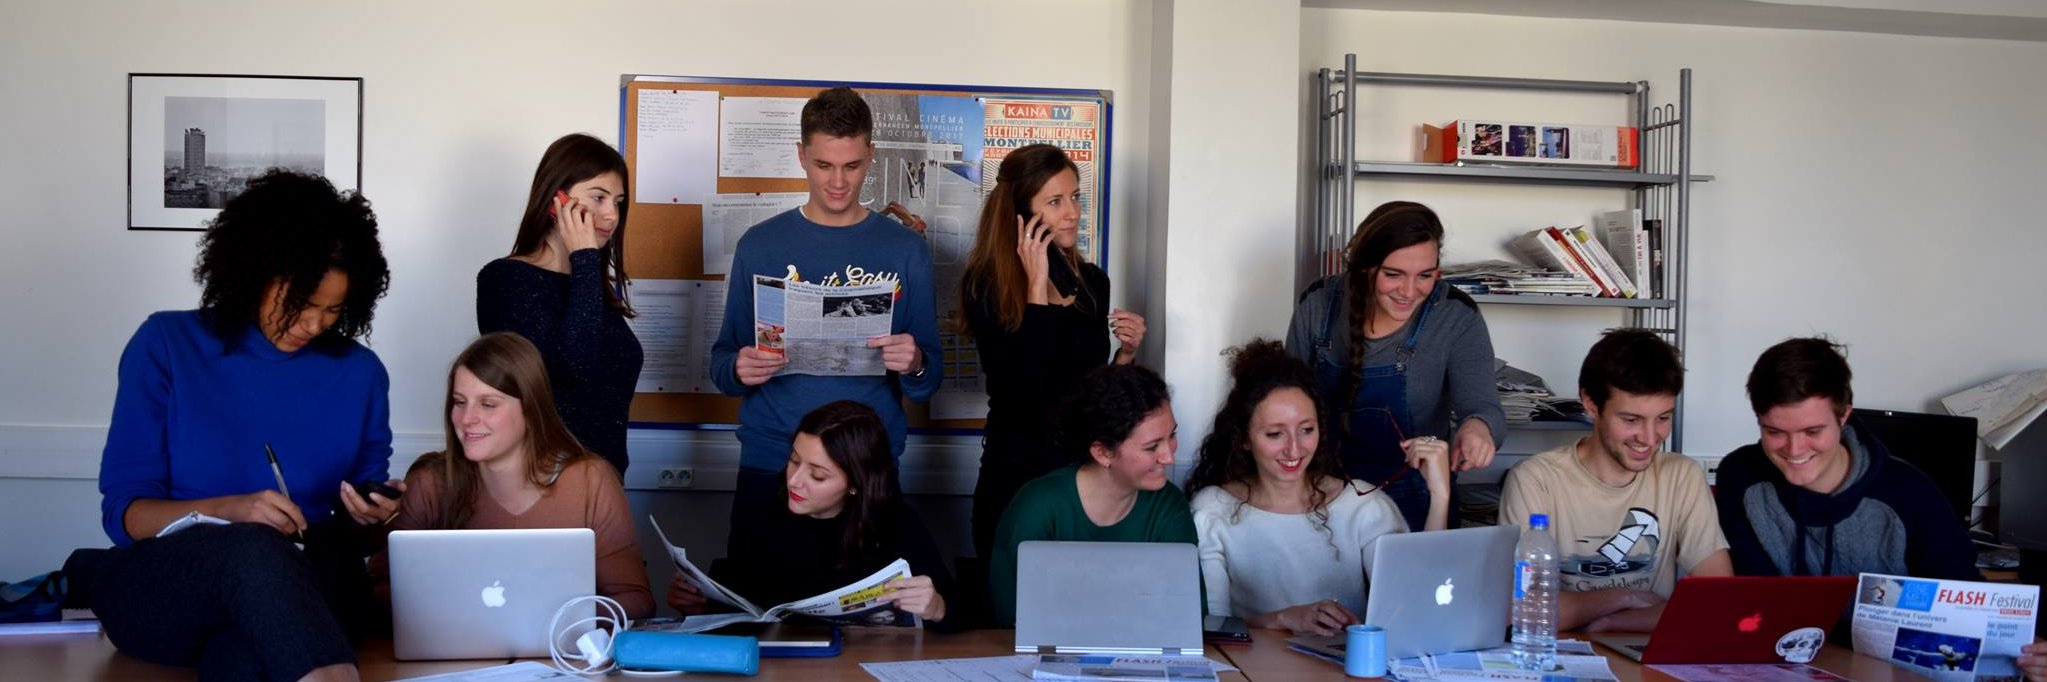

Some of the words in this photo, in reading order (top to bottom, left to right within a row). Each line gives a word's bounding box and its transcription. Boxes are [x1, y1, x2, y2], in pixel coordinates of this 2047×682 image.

[872, 112, 910, 121] TIVAL
[1007, 106, 1049, 117] KAINA
[1053, 107, 1070, 118] TV
[1033, 127, 1093, 140] MUNICIPALES
[1937, 588, 1986, 605] FLASH
[1989, 592, 2036, 609] Festival
